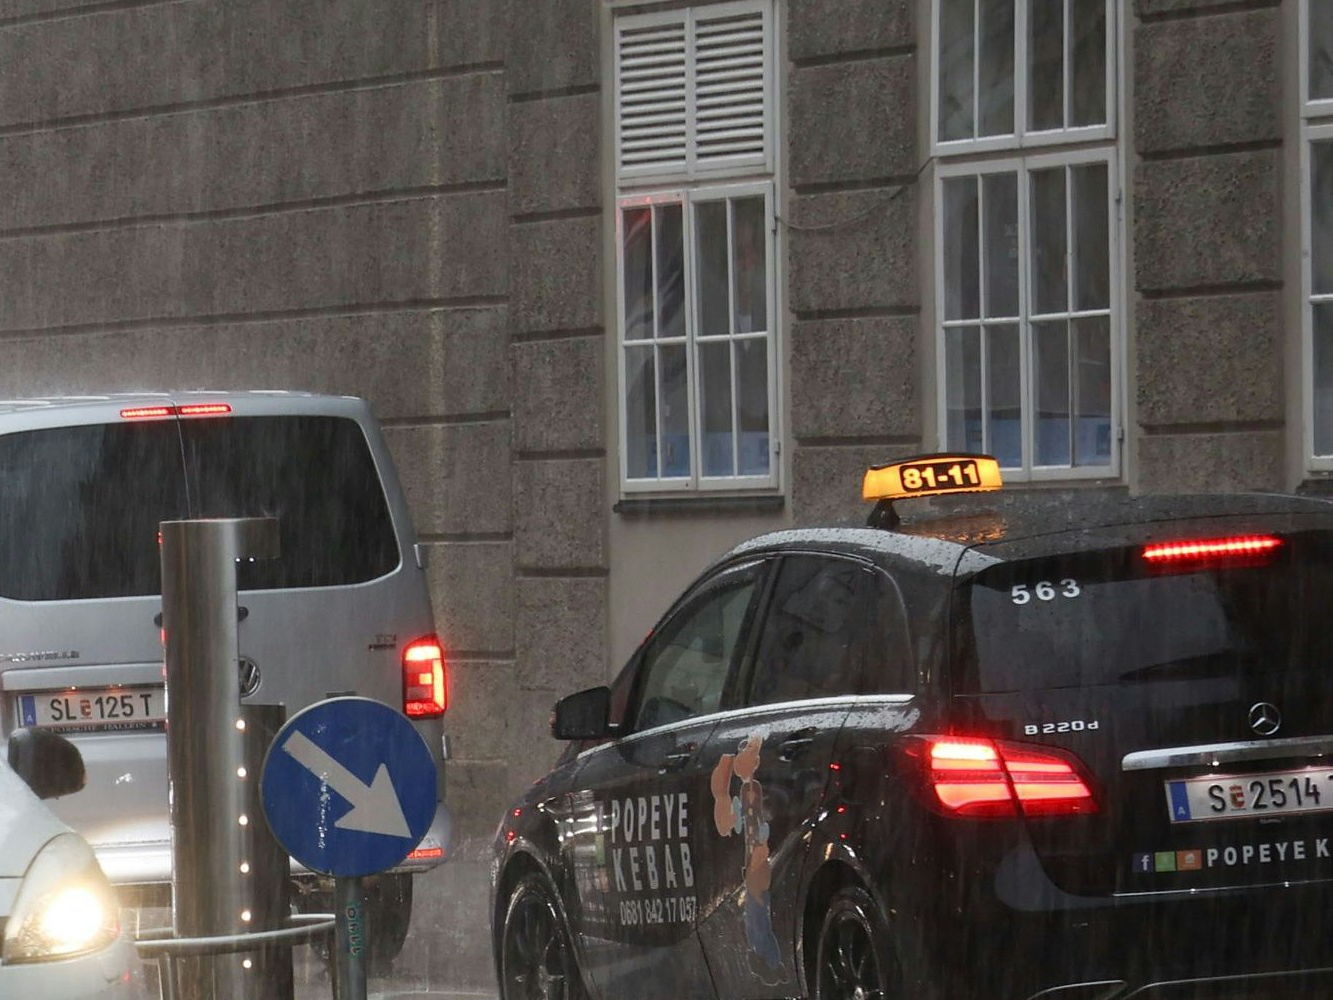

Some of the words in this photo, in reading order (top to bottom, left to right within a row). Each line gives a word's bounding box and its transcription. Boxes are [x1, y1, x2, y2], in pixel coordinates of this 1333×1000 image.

[903, 464, 978, 489] 81-11
[1011, 578, 1080, 605] 563
[50, 698, 77, 722] SL
[95, 694, 134, 719] 125
[139, 694, 152, 716] T
[1208, 784, 1226, 812] S
[1250, 777, 1320, 810] 2514
[611, 793, 688, 843] POPEYE
[613, 843, 694, 892] KEBAB
[1207, 841, 1305, 868] POPEYE
[620, 899, 643, 926] 0681
